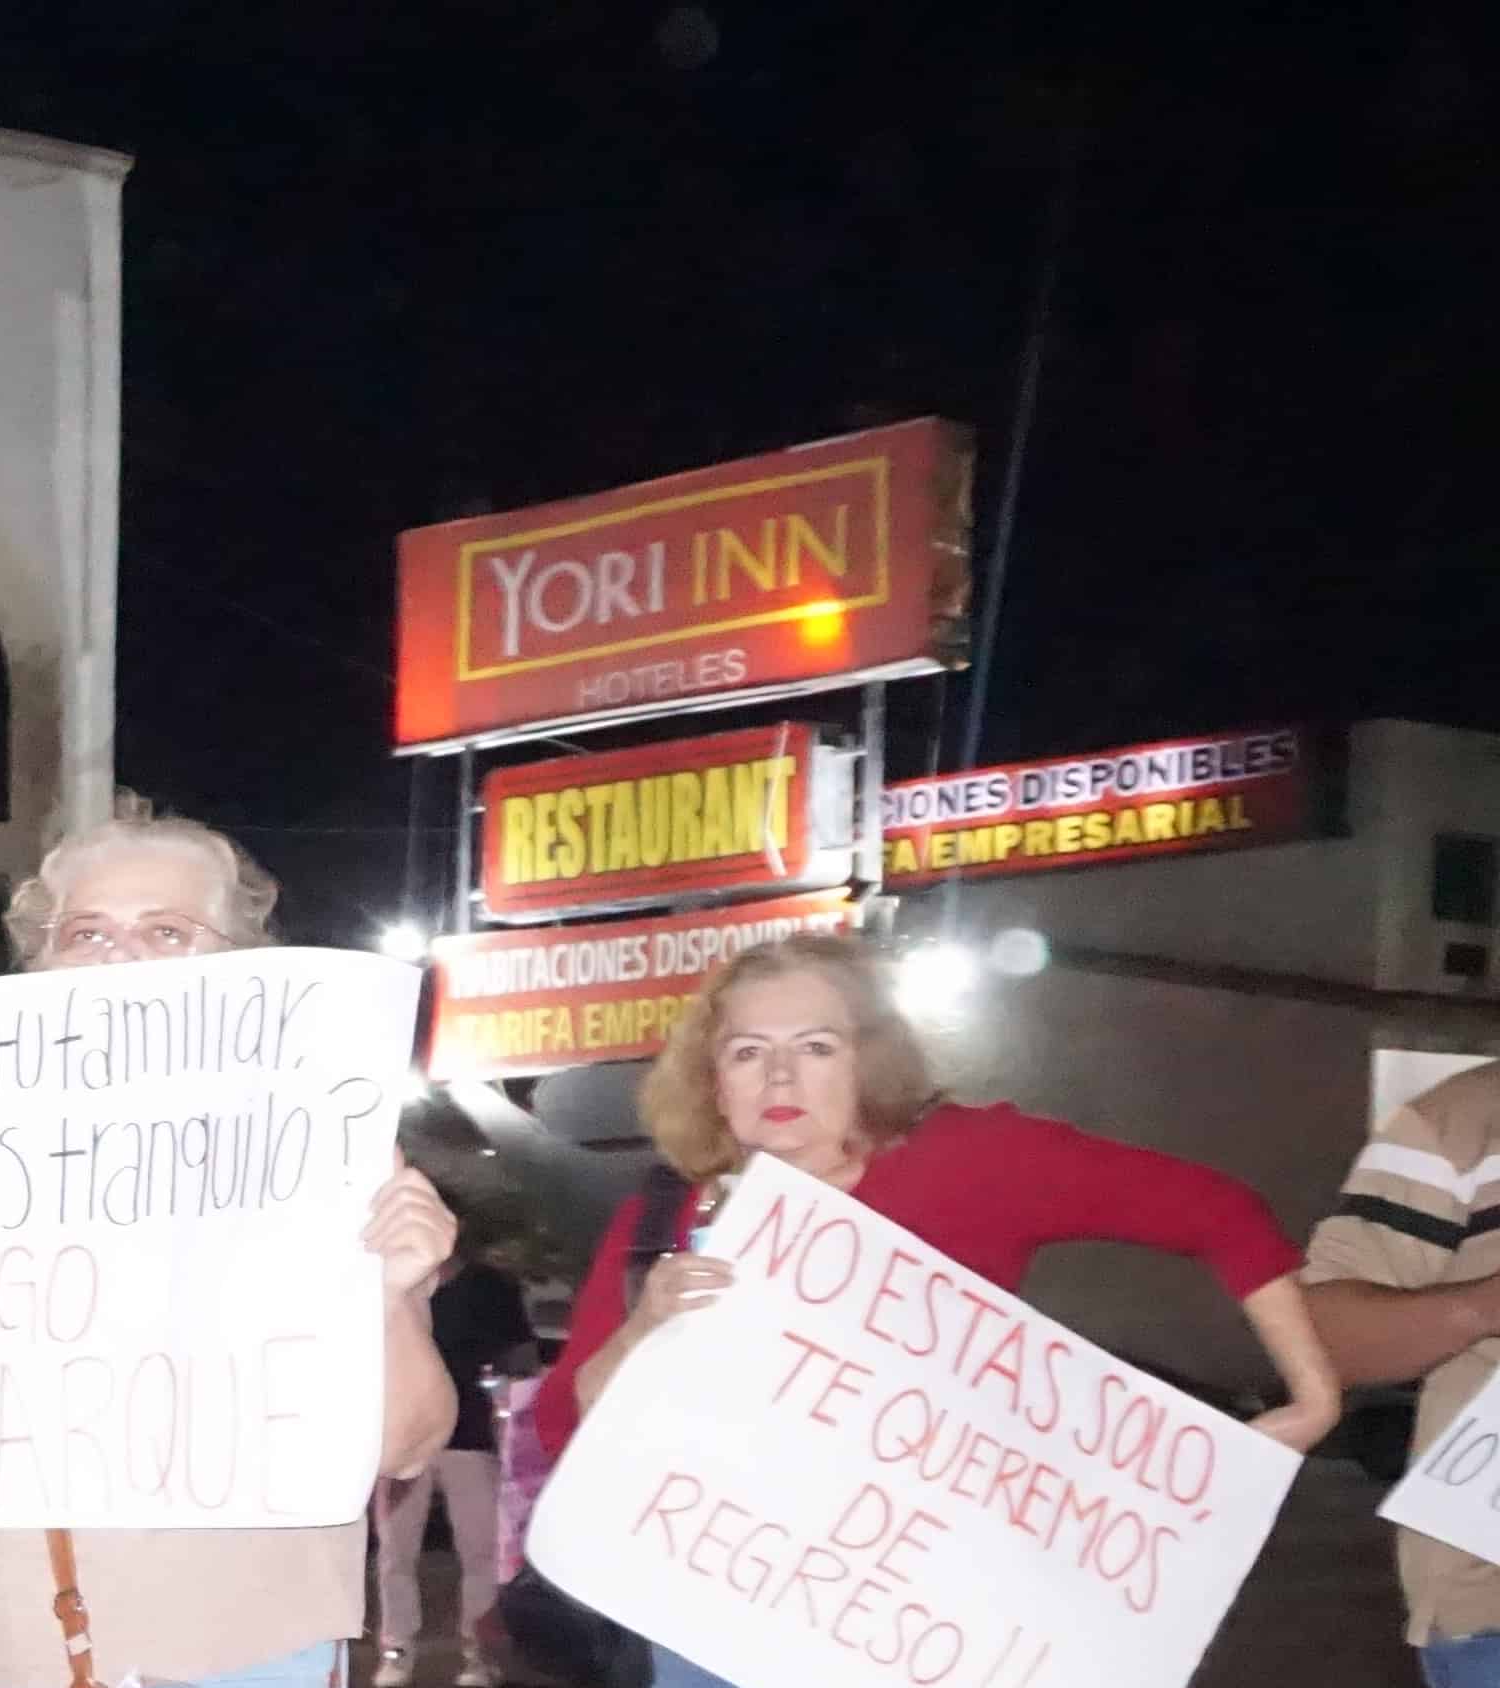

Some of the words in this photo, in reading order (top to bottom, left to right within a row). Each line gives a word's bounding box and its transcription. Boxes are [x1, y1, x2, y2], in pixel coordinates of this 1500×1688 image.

[490, 541, 665, 657] YORI
[693, 503, 849, 606] INN
[580, 648, 747, 706] HOTELES
[504, 755, 797, 885] RESTAURANT
[1021, 729, 1297, 806] DISPONIBLES
[932, 795, 1253, 868] EMPRESARIAL
[737, 1192, 862, 1305] NO
[864, 1250, 1073, 1434] ESTAS
[773, 1330, 877, 1431] TE
[871, 1388, 1182, 1616] QUEREMOS
[829, 1482, 952, 1588] DE
